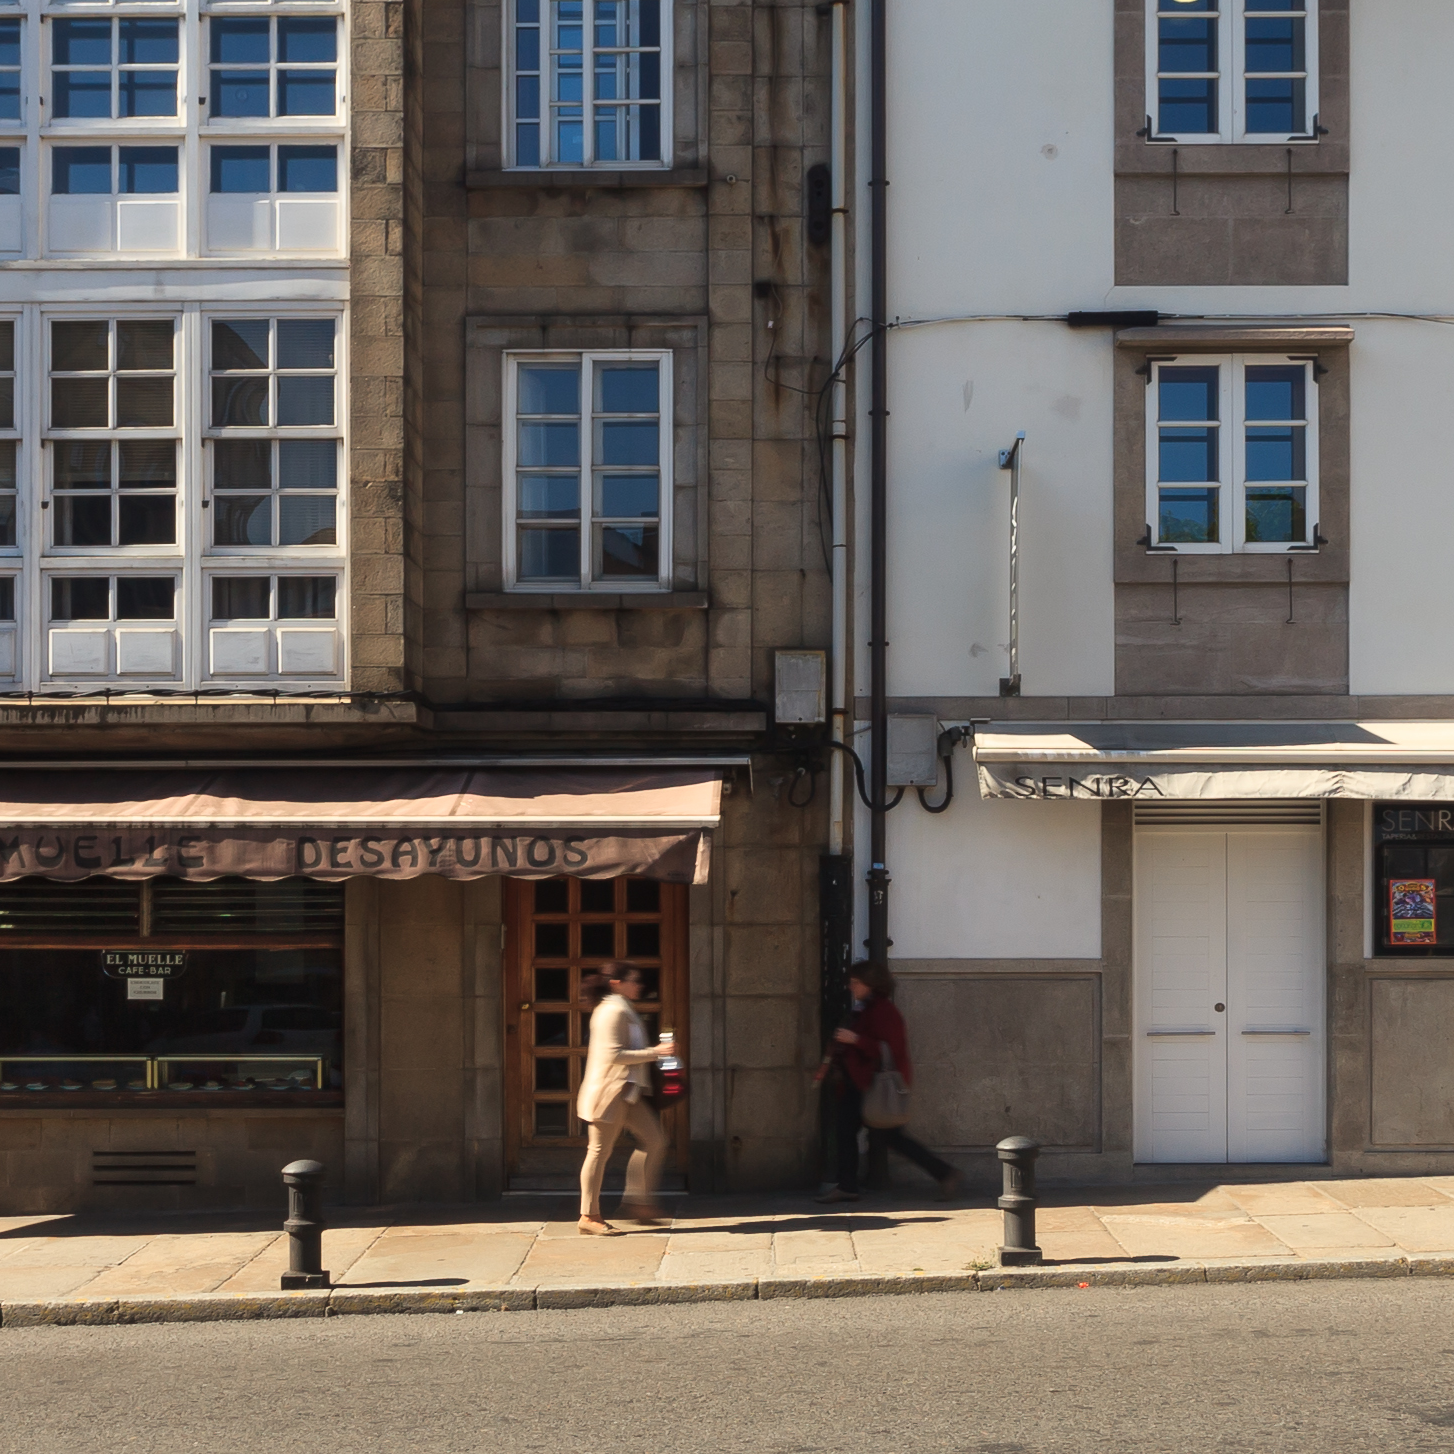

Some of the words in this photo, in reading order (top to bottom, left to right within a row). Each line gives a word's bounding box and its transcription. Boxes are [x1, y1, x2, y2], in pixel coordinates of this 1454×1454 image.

[1014, 776, 1165, 797] SENRA
[297, 834, 589, 869] DESAYUNOS
[106, 954, 124, 965] EL
[127, 954, 184, 965] MUELLE
